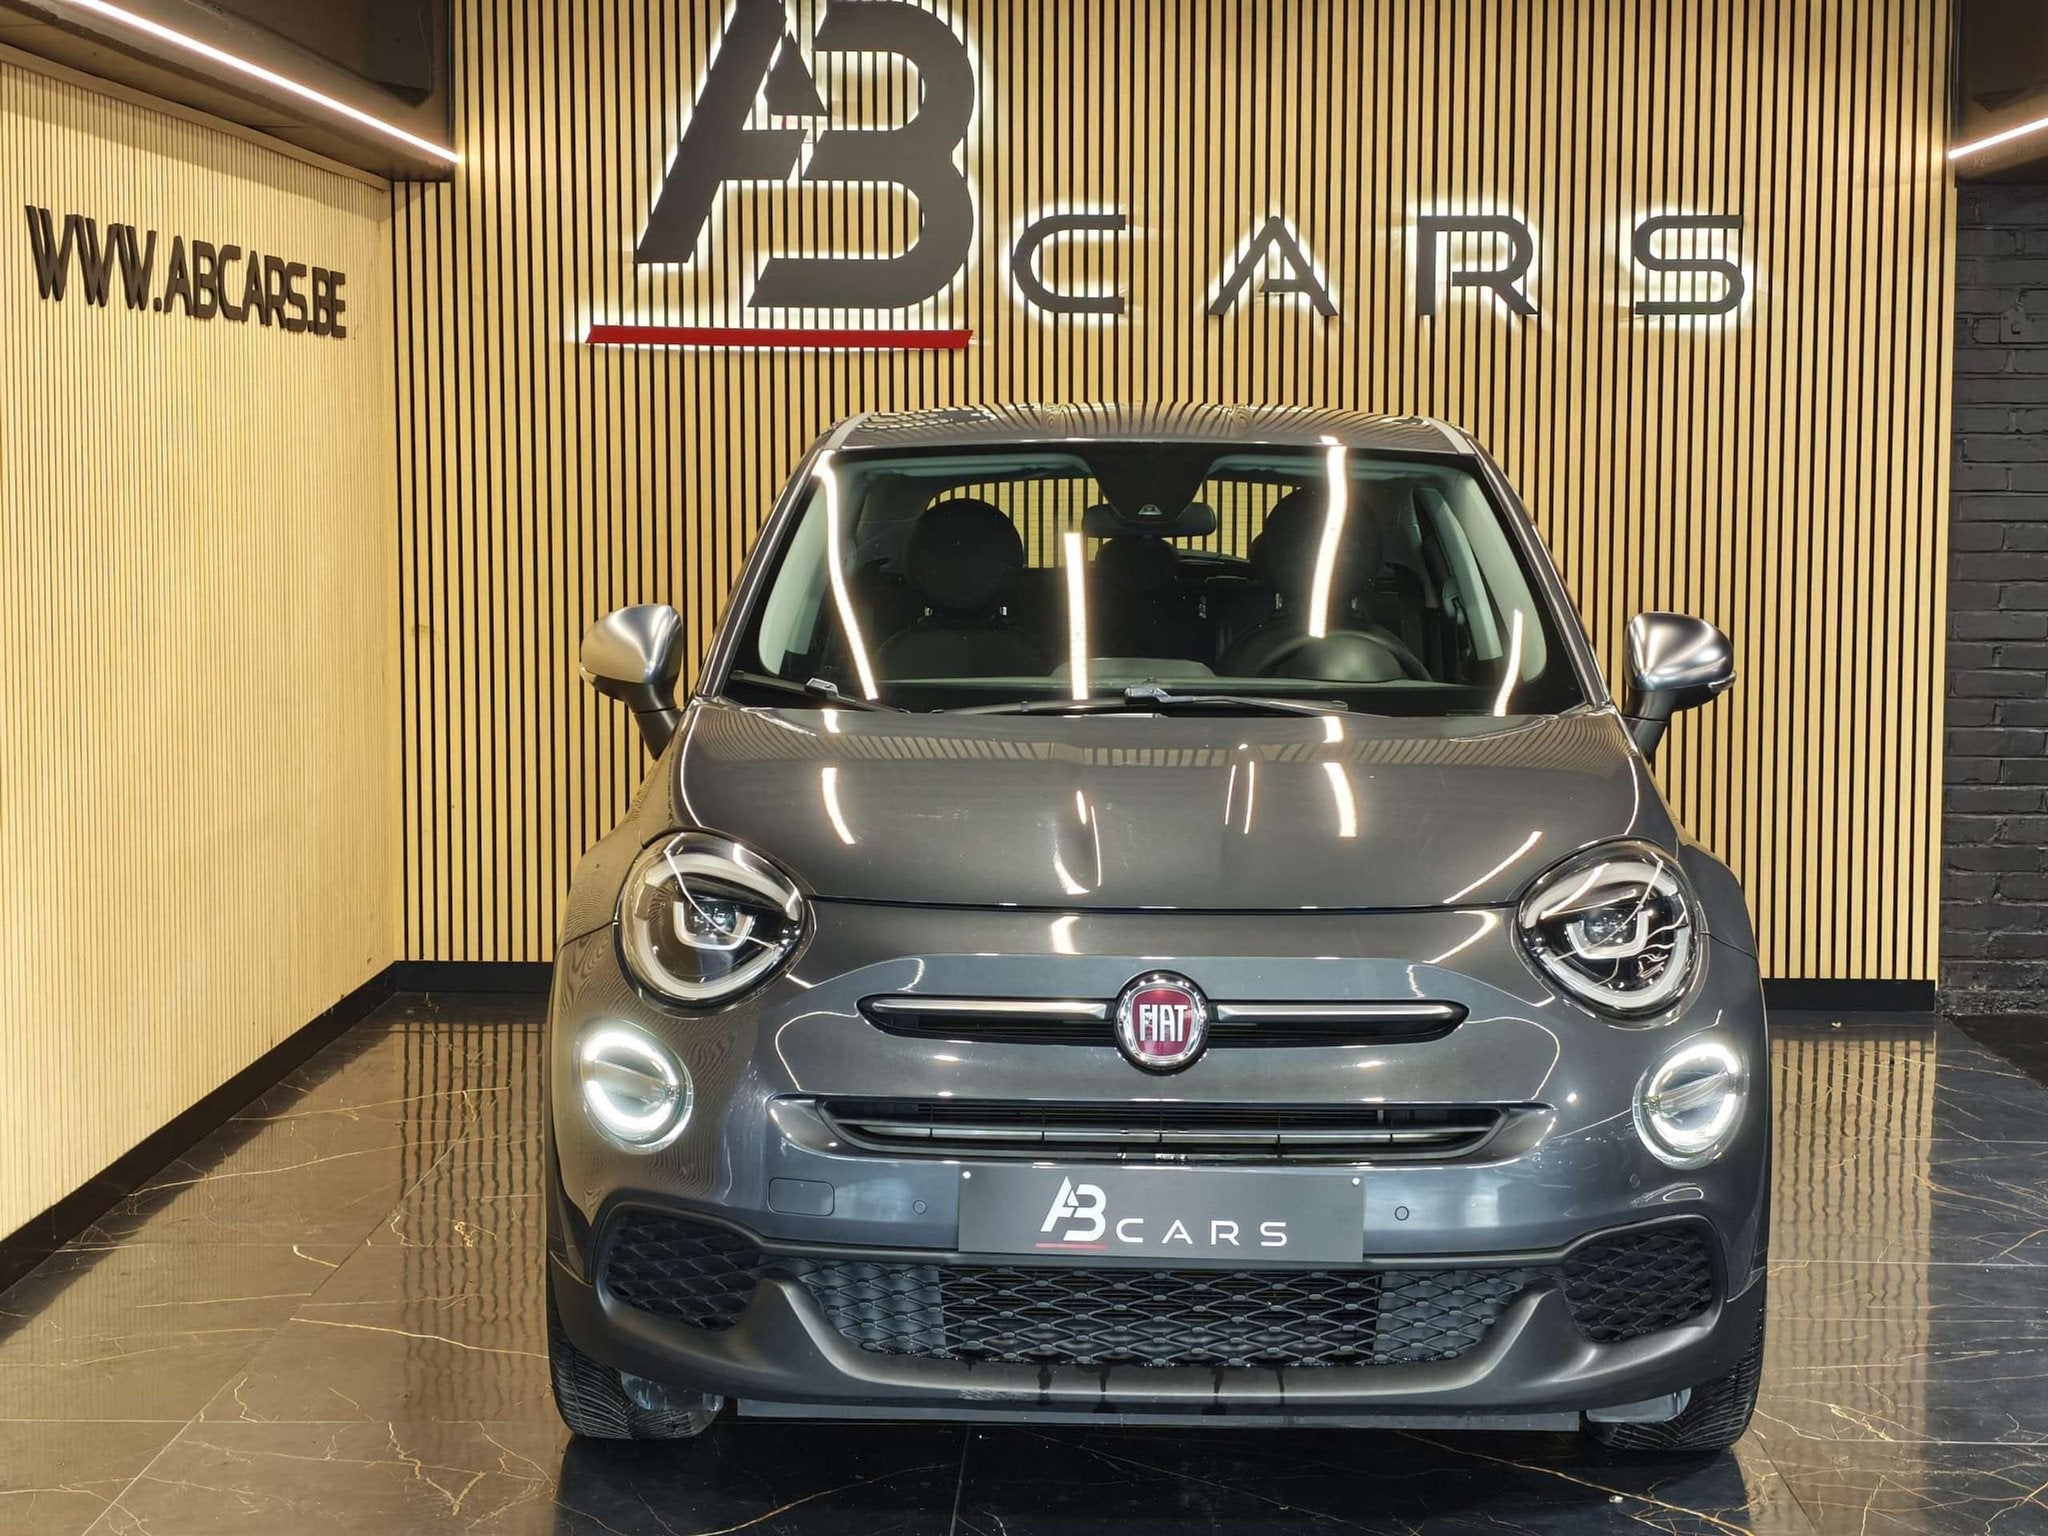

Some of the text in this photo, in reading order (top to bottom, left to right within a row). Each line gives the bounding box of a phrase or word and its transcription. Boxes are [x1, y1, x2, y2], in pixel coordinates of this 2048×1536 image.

[634, 0, 1746, 317] AB CARS
[25, 205, 347, 339] WWW.ABCARS.BE
[1138, 1003, 1188, 1042] FIAT
[1039, 1176, 1287, 1247] AB CARS
